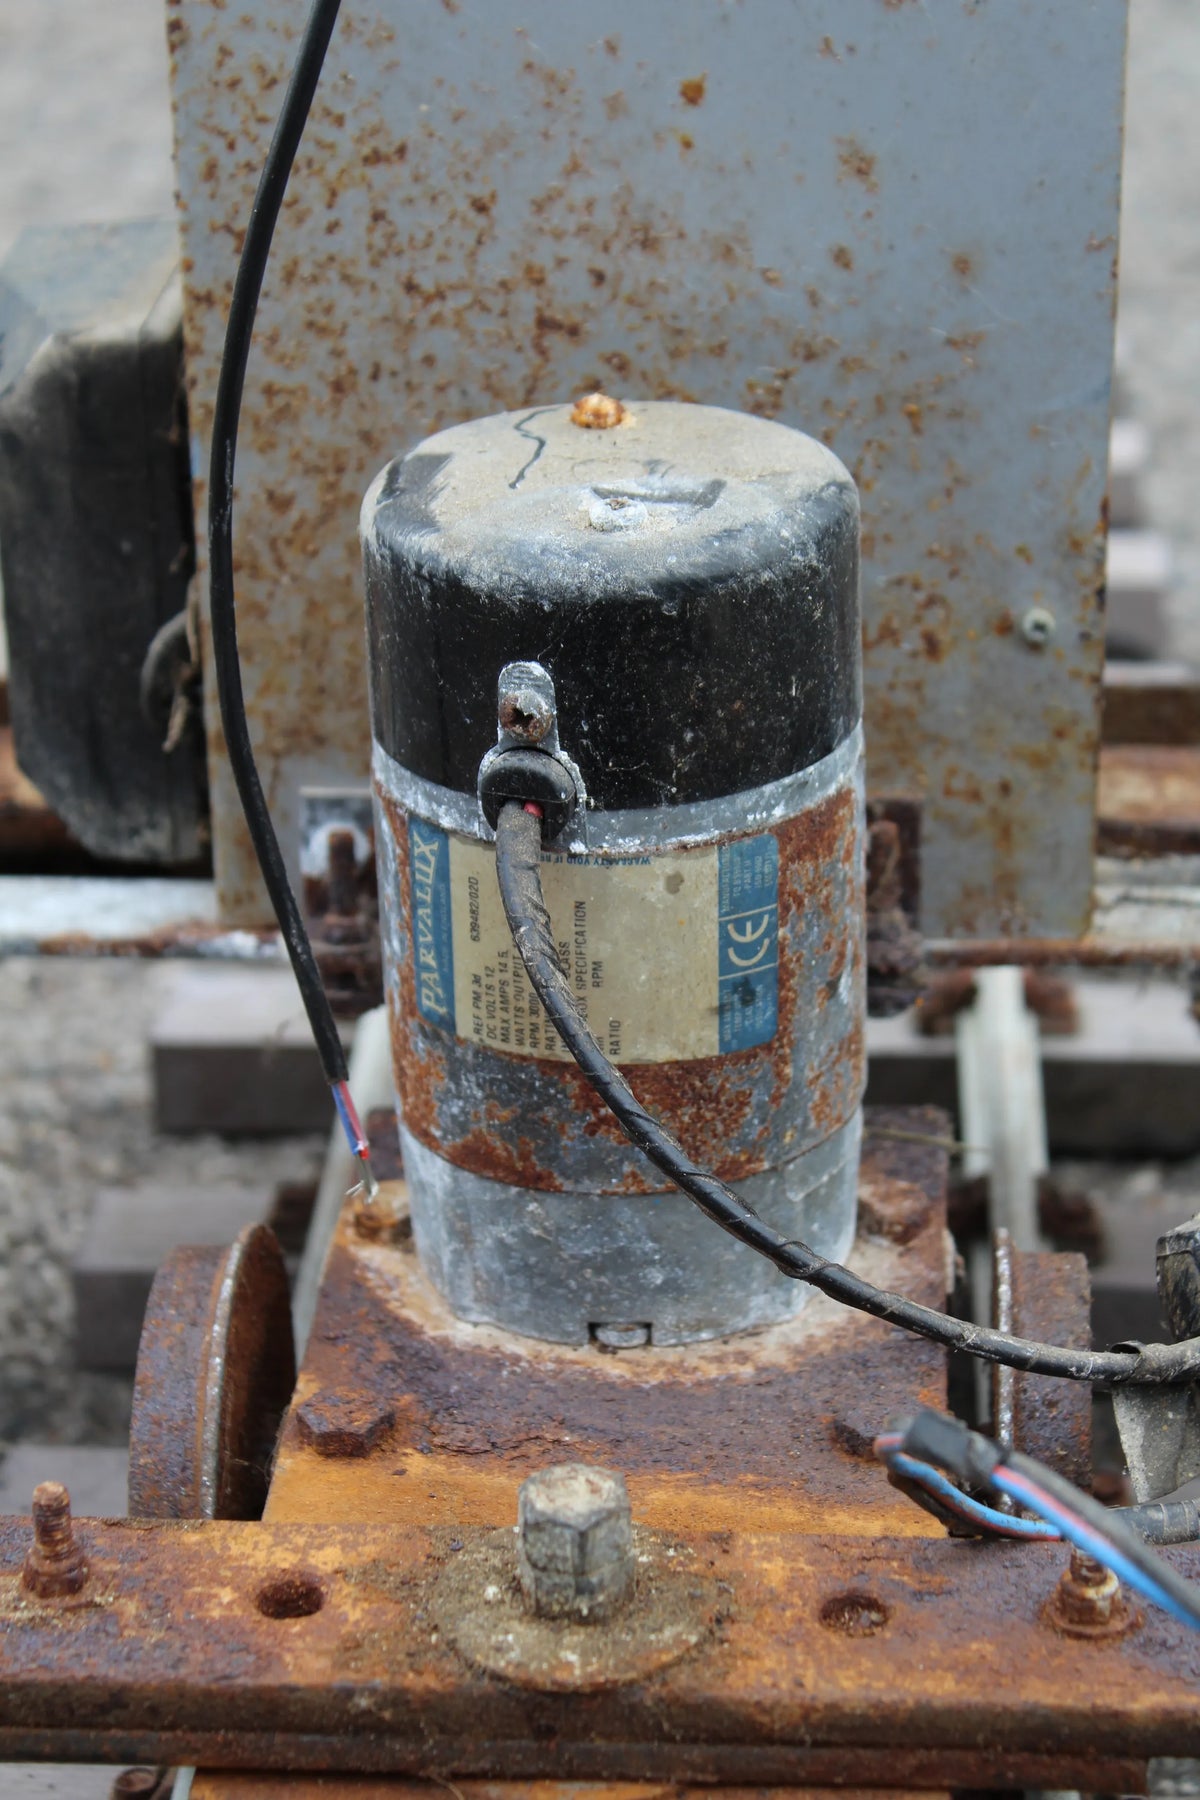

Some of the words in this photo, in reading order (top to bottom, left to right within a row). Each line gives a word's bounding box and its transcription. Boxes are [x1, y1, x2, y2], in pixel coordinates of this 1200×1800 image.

[567, 856, 590, 865] VOID
[413, 830, 448, 1015] PARVALUX
[574, 900, 587, 990] SPECIFICATION
[727, 914, 770, 967] CE
[485, 966, 494, 978] 12
[513, 956, 524, 1001] OUTPUT
[592, 961, 604, 988] RPM
[472, 991, 481, 1009] PM
[485, 985, 496, 1019] VOLTS
[499, 980, 510, 1013] AMPS
[473, 1013, 483, 1035] REF
[486, 1025, 497, 1039] DC
[500, 1018, 511, 1043] MAX
[514, 1007, 525, 1046] WATTS
[529, 1022, 540, 1048] RPM
[544, 1009, 556, 1051] RATIN
[609, 1020, 621, 1055] RATIO
